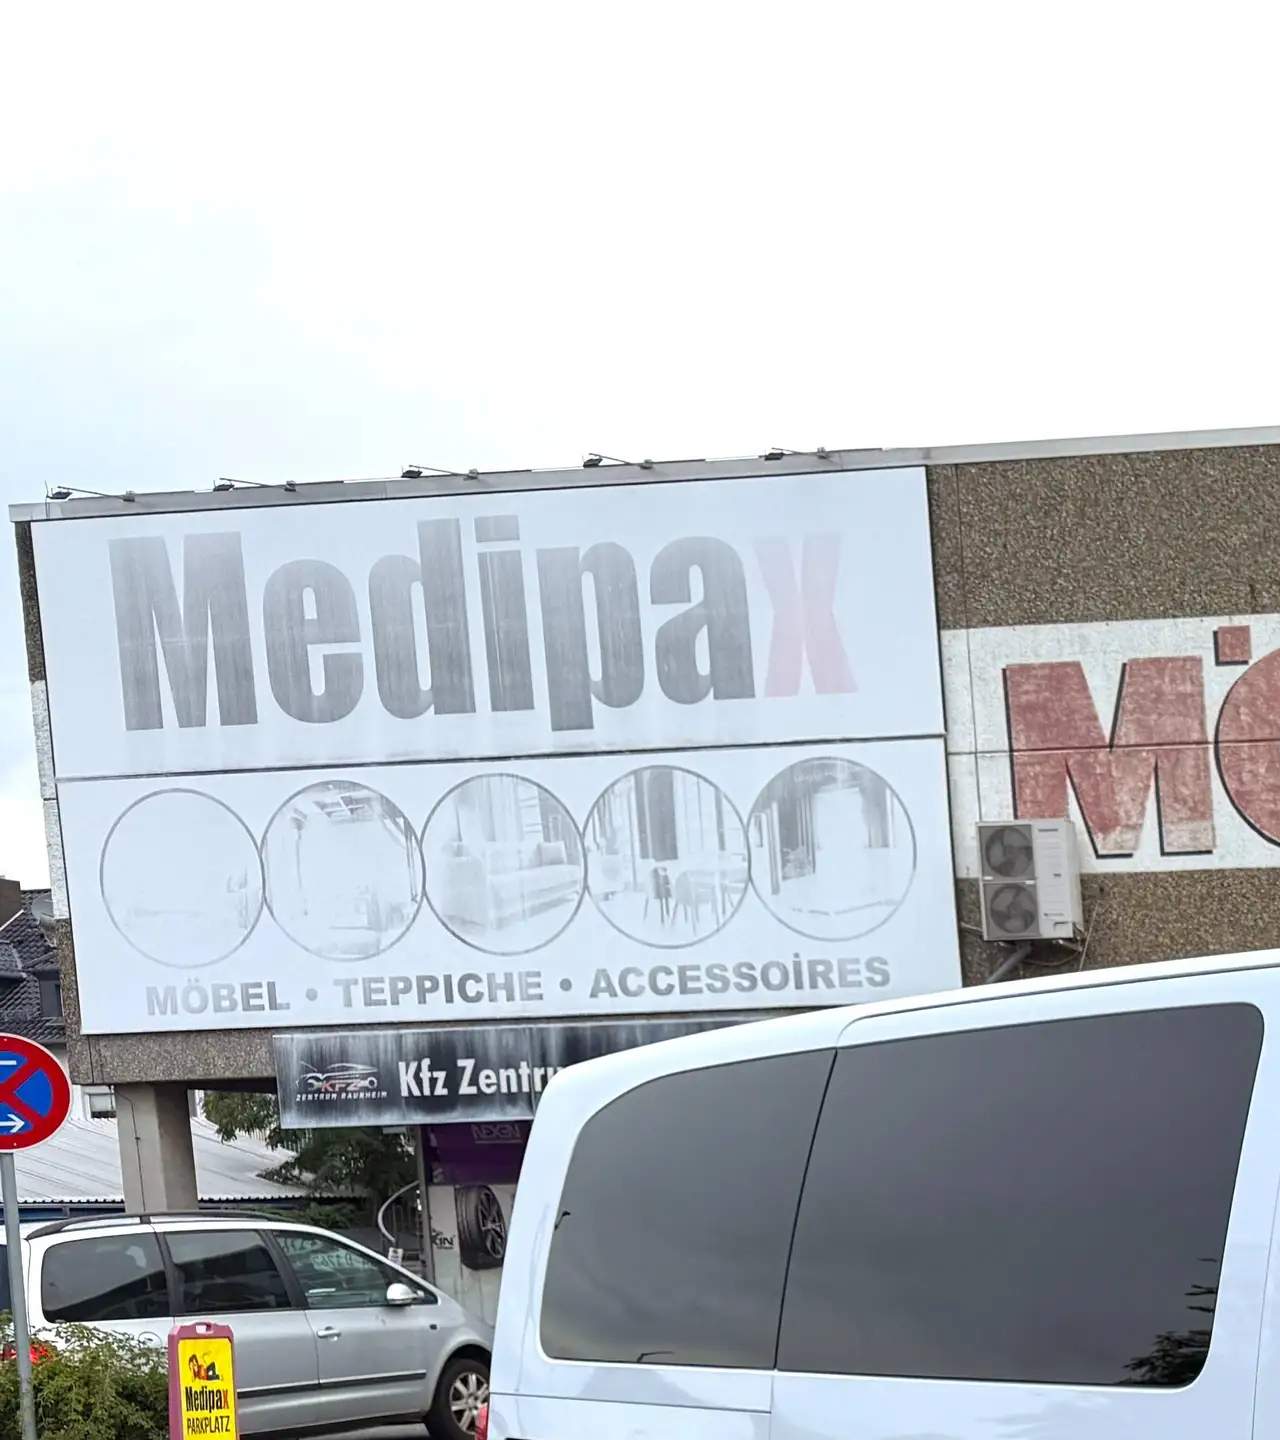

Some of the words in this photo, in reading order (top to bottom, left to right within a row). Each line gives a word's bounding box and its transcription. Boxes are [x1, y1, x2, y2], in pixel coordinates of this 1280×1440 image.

[108, 514, 859, 732] Medipax
[146, 978, 291, 1016] MÖBEL
[333, 970, 544, 1008] TEPPICHE
[320, 1079, 361, 1092] KFZ
[399, 1058, 449, 1097] Kfz
[295, 1092, 338, 1102] ZENTRUM
[185, 1385, 230, 1413] Medipax
[186, 1415, 231, 1435] PARKPLATZ
